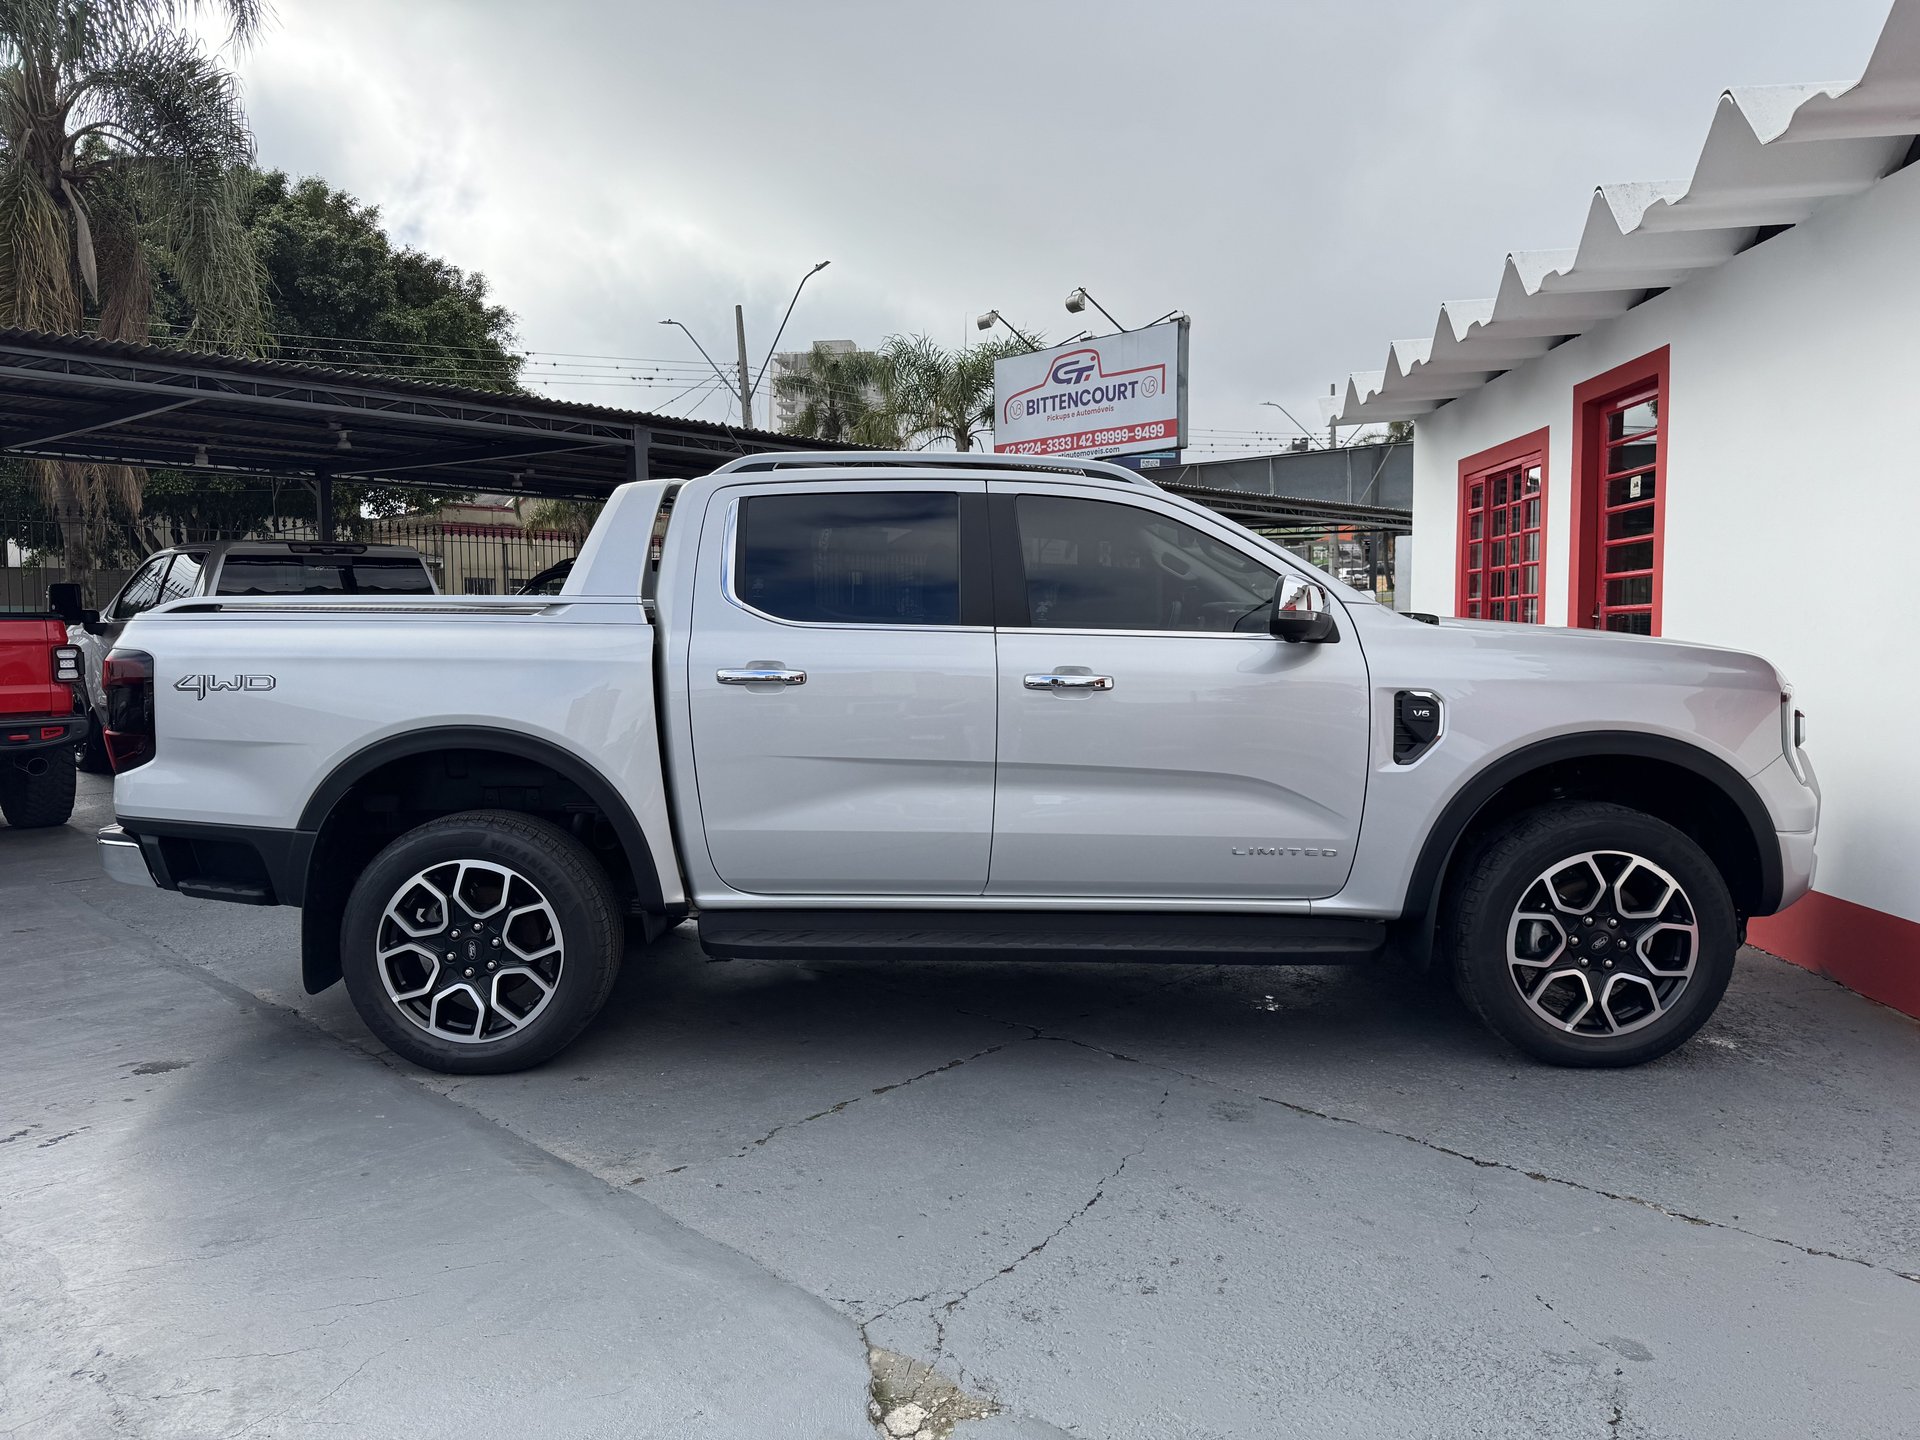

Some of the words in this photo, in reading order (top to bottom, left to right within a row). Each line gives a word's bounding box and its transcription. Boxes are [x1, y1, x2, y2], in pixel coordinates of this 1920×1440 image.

[1026, 380, 1139, 416] BITTENCOURT
[1046, 413, 1070, 422] Pickups
[1076, 405, 1114, 417] Automóveis
[1017, 436, 1071, 455] 3224-3333
[1079, 433, 1092, 447] 42
[1095, 423, 1165, 445] 99999-9499
[173, 675, 277, 701] 4WD
[1413, 709, 1430, 717] V6
[1232, 847, 1338, 858] LIMITED
